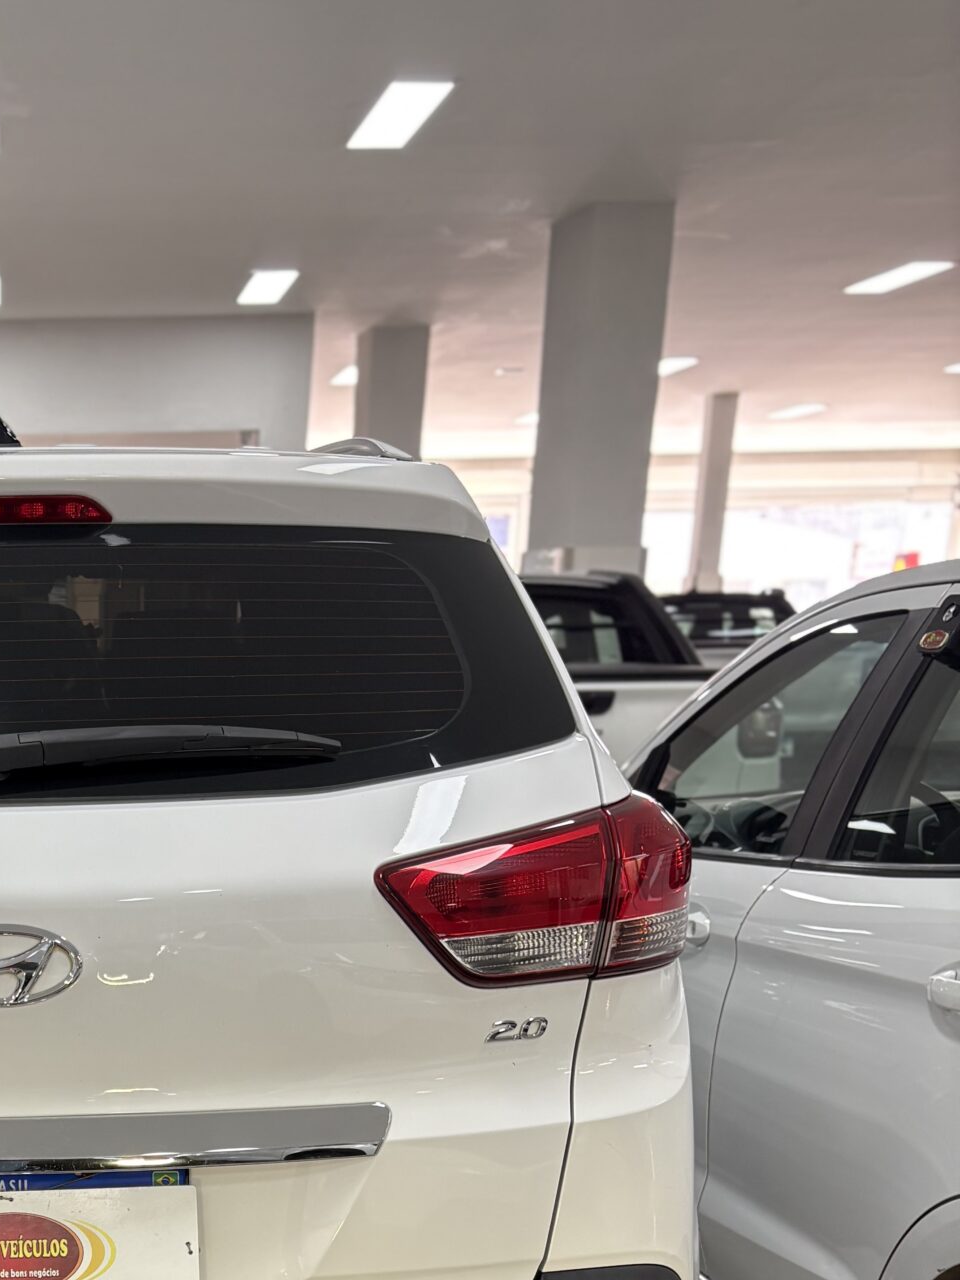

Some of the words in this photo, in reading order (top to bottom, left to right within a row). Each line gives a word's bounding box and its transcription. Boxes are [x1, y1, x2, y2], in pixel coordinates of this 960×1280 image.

[484, 1016, 549, 1042] 2.0
[0, 1235, 69, 1259] VEÍCULOS
[0, 1269, 10, 1278] de
[10, 1268, 28, 1278] bons
[29, 1267, 60, 1279] negócios
